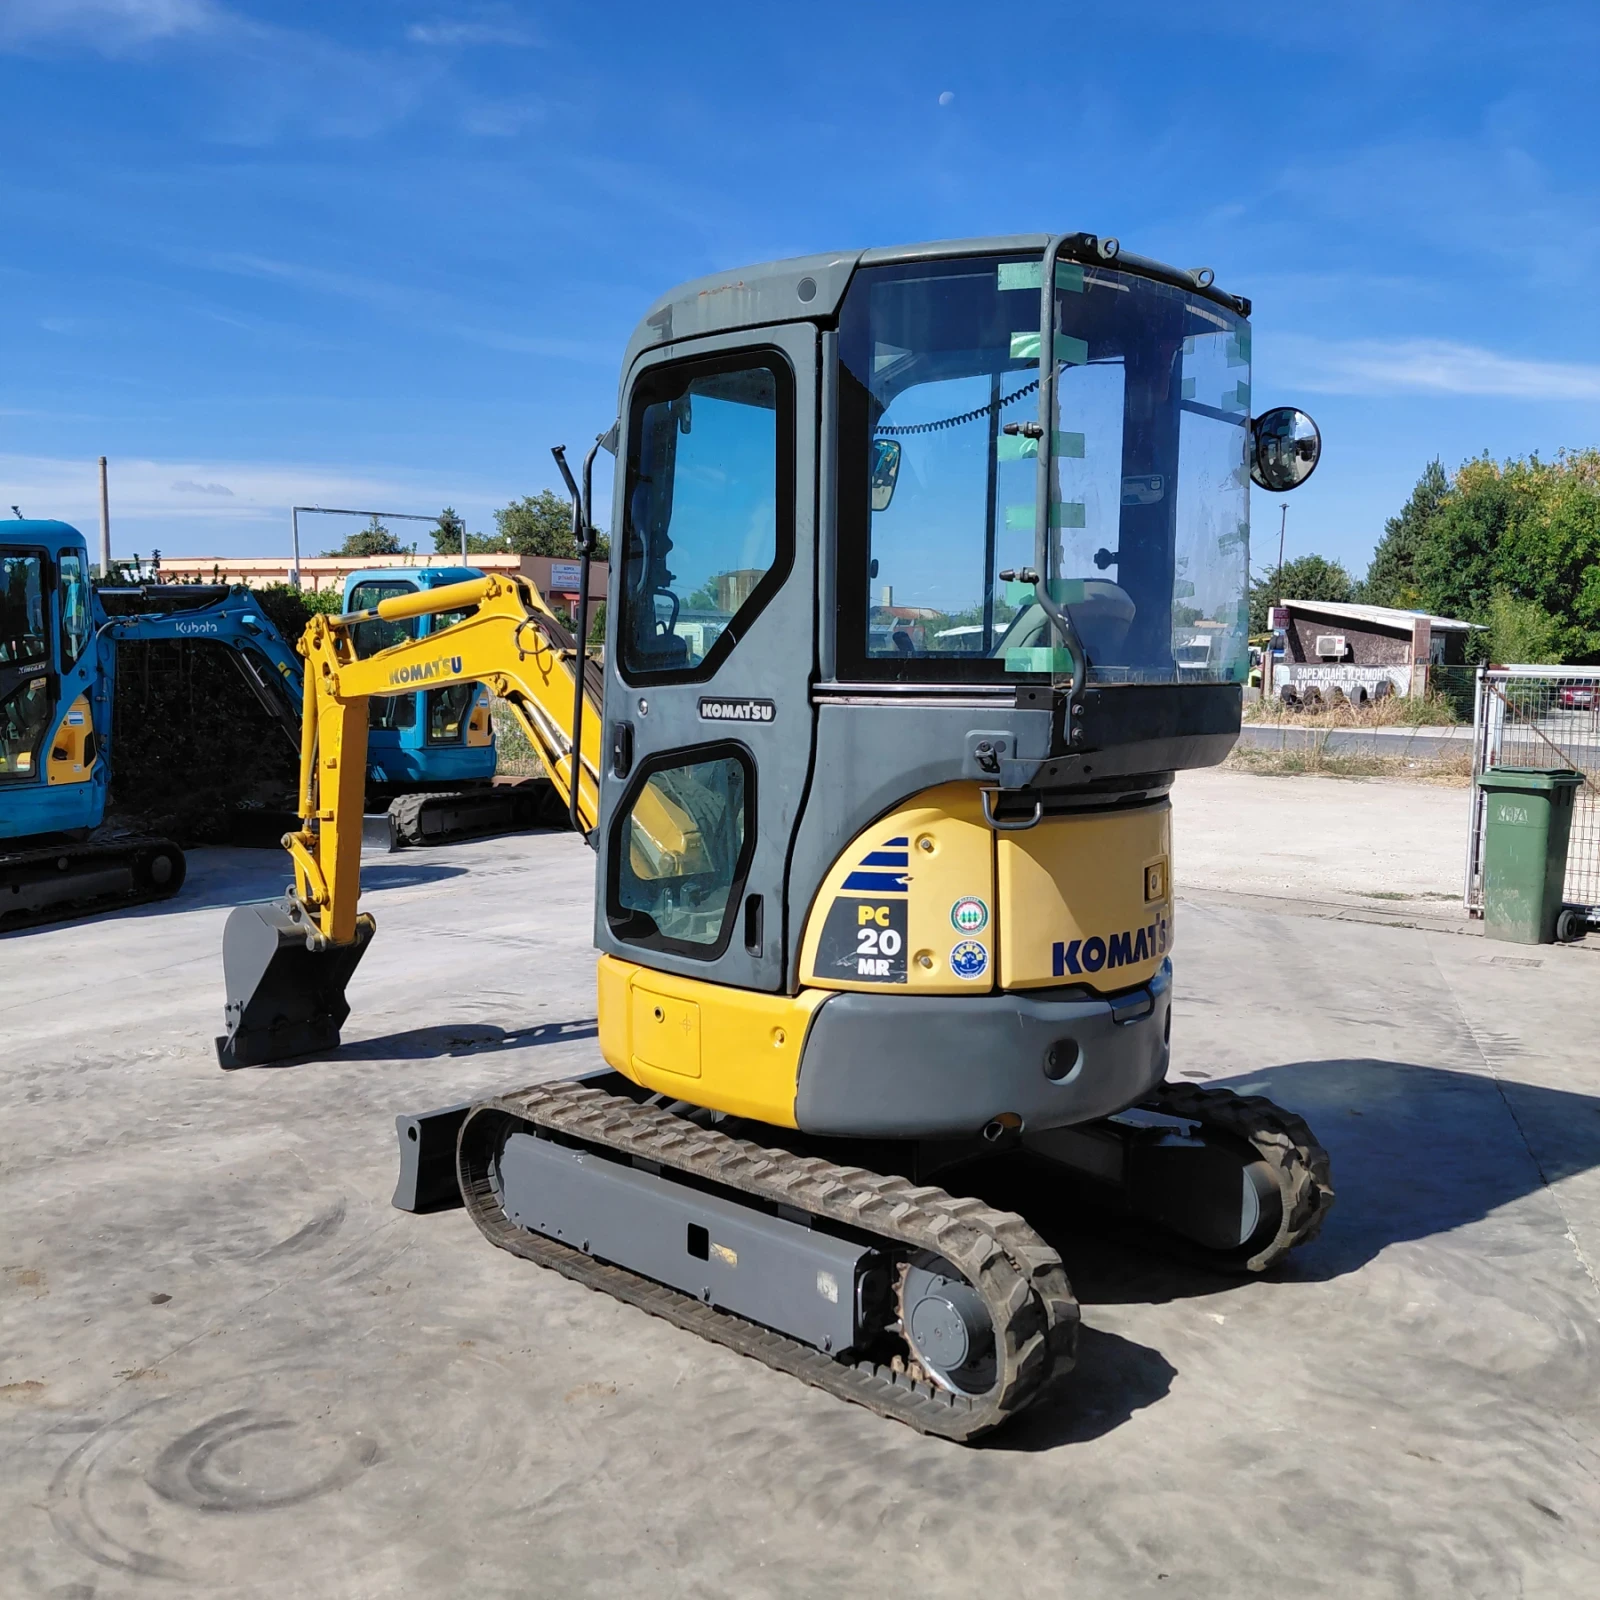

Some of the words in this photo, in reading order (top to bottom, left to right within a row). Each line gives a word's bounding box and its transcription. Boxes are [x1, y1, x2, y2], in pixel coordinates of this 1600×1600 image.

[175, 621, 218, 634] Kubota
[389, 654, 462, 685] KOMATSU
[1297, 668, 1347, 680] ЗАРЕЖДАНЕ
[1355, 668, 1387, 680] РЕМОНТ
[702, 702, 772, 720] KOMATSU
[858, 905, 890, 927] PC
[857, 928, 902, 956] 20
[857, 958, 891, 976] MR
